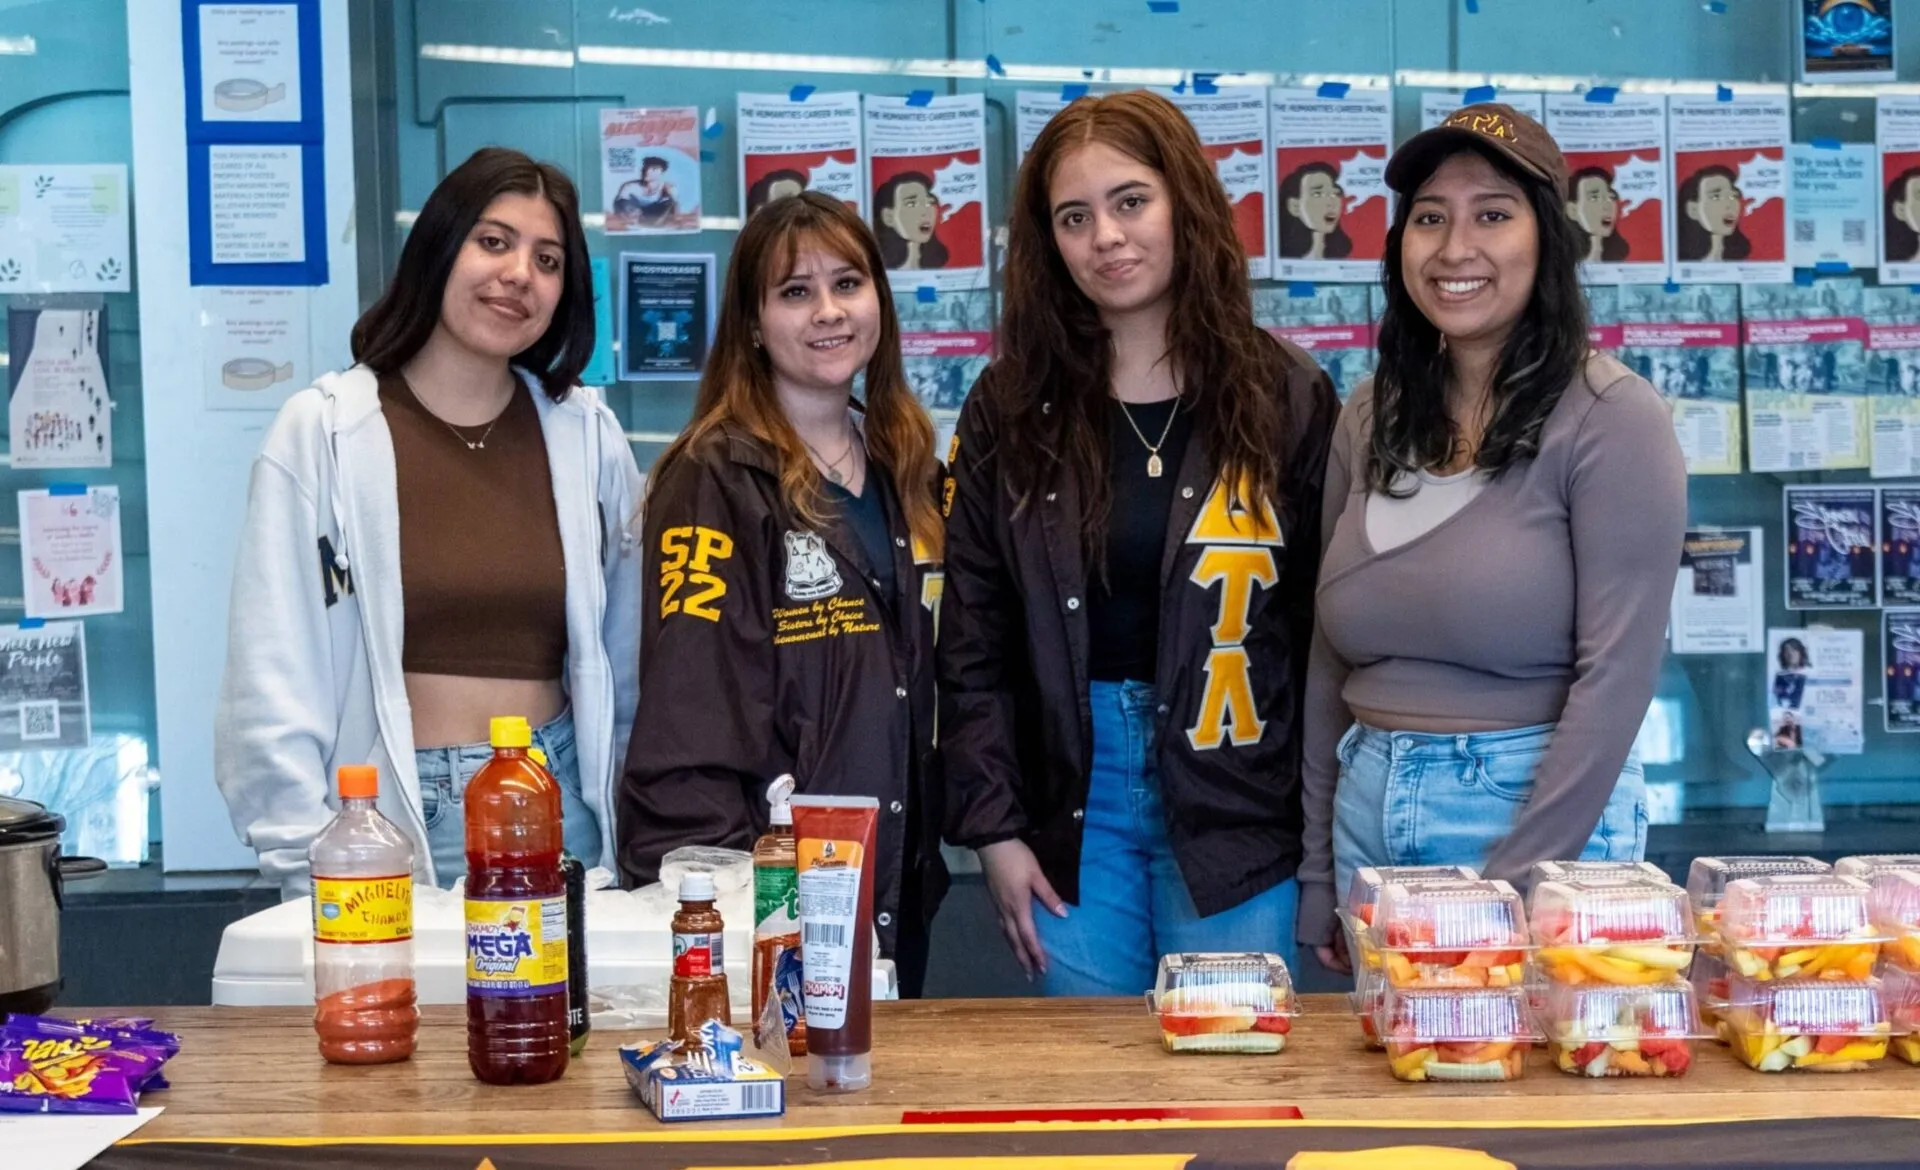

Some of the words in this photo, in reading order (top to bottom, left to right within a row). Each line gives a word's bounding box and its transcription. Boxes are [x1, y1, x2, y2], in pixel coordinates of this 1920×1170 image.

[1793, 157, 1812, 168] We
[1816, 157, 1841, 168] took
[1845, 157, 1865, 168] the
[1793, 170, 1829, 182] coffee
[1832, 170, 1863, 182] chats
[1793, 180, 1812, 190] for
[661, 526, 734, 573] SP
[660, 570, 727, 622] 22
[772, 608, 810, 619] Women
[812, 601, 824, 612] by
[828, 597, 864, 610] Chance
[778, 620, 814, 632] Sisters
[816, 614, 828, 626] by
[832, 611, 864, 624] Choice
[828, 624, 840, 636] by
[842, 621, 880, 634] Nature
[8, 650, 63, 672] People
[467, 932, 532, 959] MEGA
[475, 956, 520, 977] Original
[805, 982, 845, 1000] CHAMOY
